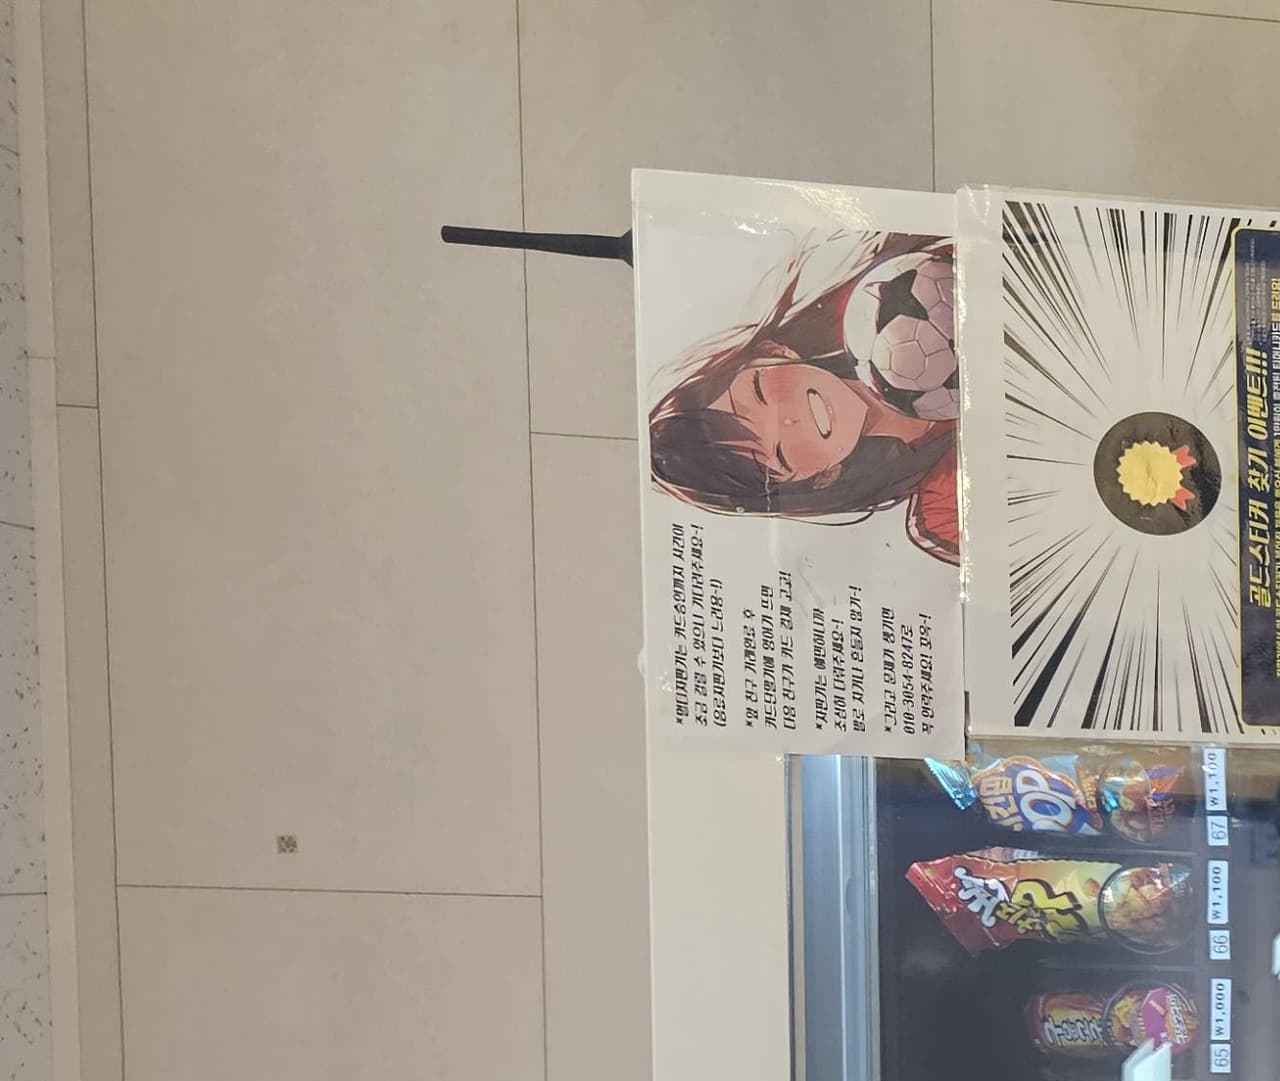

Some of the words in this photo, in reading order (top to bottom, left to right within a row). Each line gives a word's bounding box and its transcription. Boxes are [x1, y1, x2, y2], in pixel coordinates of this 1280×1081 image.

[1272, 278, 1280, 310] 드려요!
[1246, 346, 1269, 440] 이벤트!!!
[1247, 448, 1270, 493] 찾기
[672, 523, 686, 561] 시간이
[1248, 498, 1272, 608] 골드스티커
[672, 565, 686, 640] 카드승인까지
[760, 585, 774, 610] 뜨면
[778, 570, 792, 602] 고고!
[692, 614, 706, 652] 있으니
[762, 614, 775, 651] 영어가
[780, 604, 793, 630] 결제
[694, 655, 707, 667] 수
[780, 634, 794, 660] 카드
[694, 672, 708, 696] 걸릴
[712, 637, 727, 727] (음료자판기보다
[763, 656, 777, 728] 카드단말기에
[781, 663, 796, 700] 친구가
[901, 624, 916, 734] 010-3054-8247로
[920, 654, 934, 719] 연락주세요!
[694, 701, 708, 727] 조금
[782, 704, 797, 730] 다음
[834, 695, 847, 732] 조심히
[1214, 1048, 1228, 1068] 65
